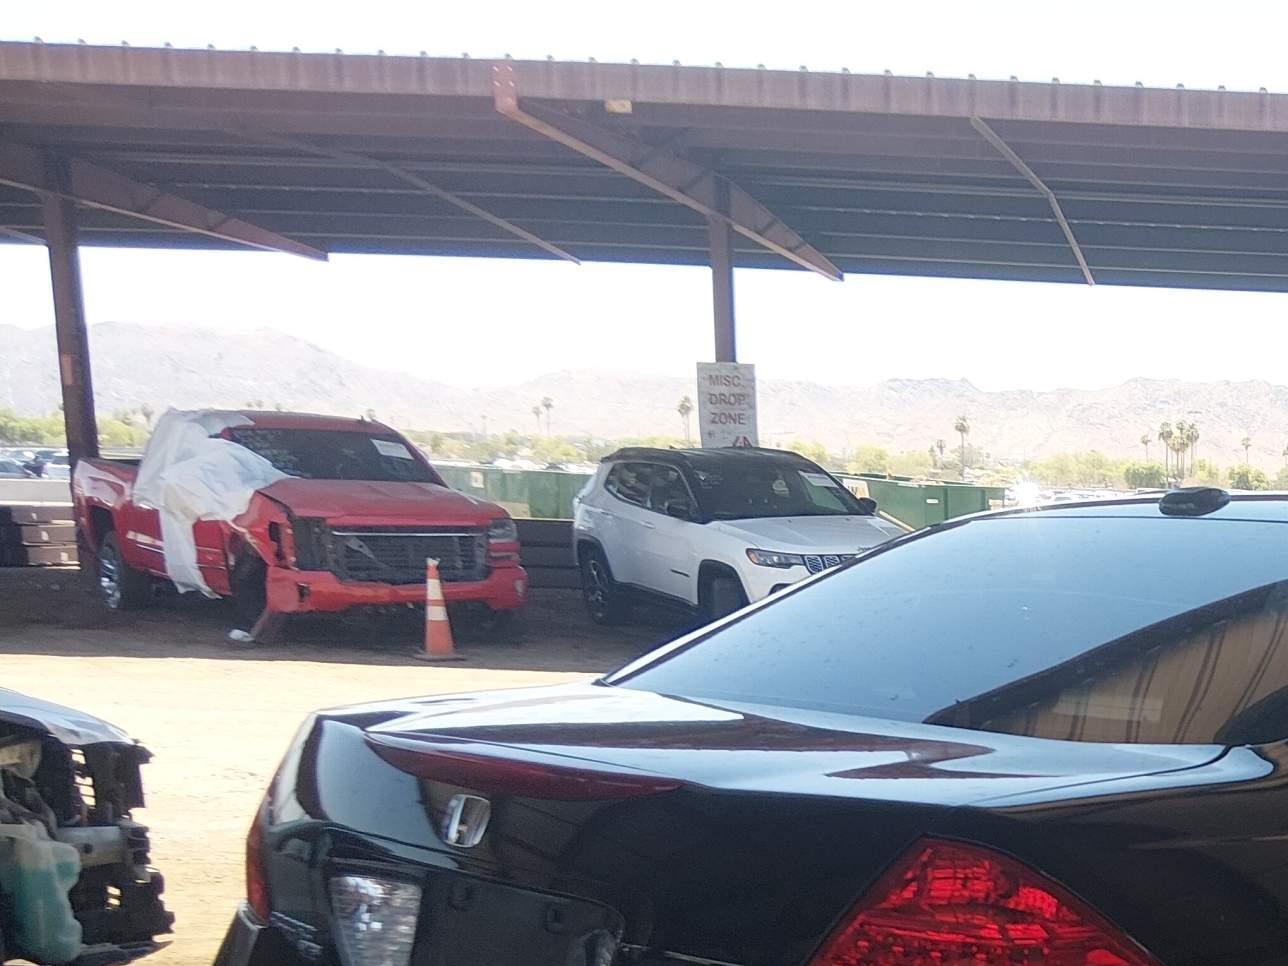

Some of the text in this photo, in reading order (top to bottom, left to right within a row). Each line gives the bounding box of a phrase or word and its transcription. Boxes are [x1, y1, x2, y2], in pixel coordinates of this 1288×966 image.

[709, 375, 745, 387] MISC.
[708, 392, 746, 406] DROP
[710, 412, 746, 425] ZONE
